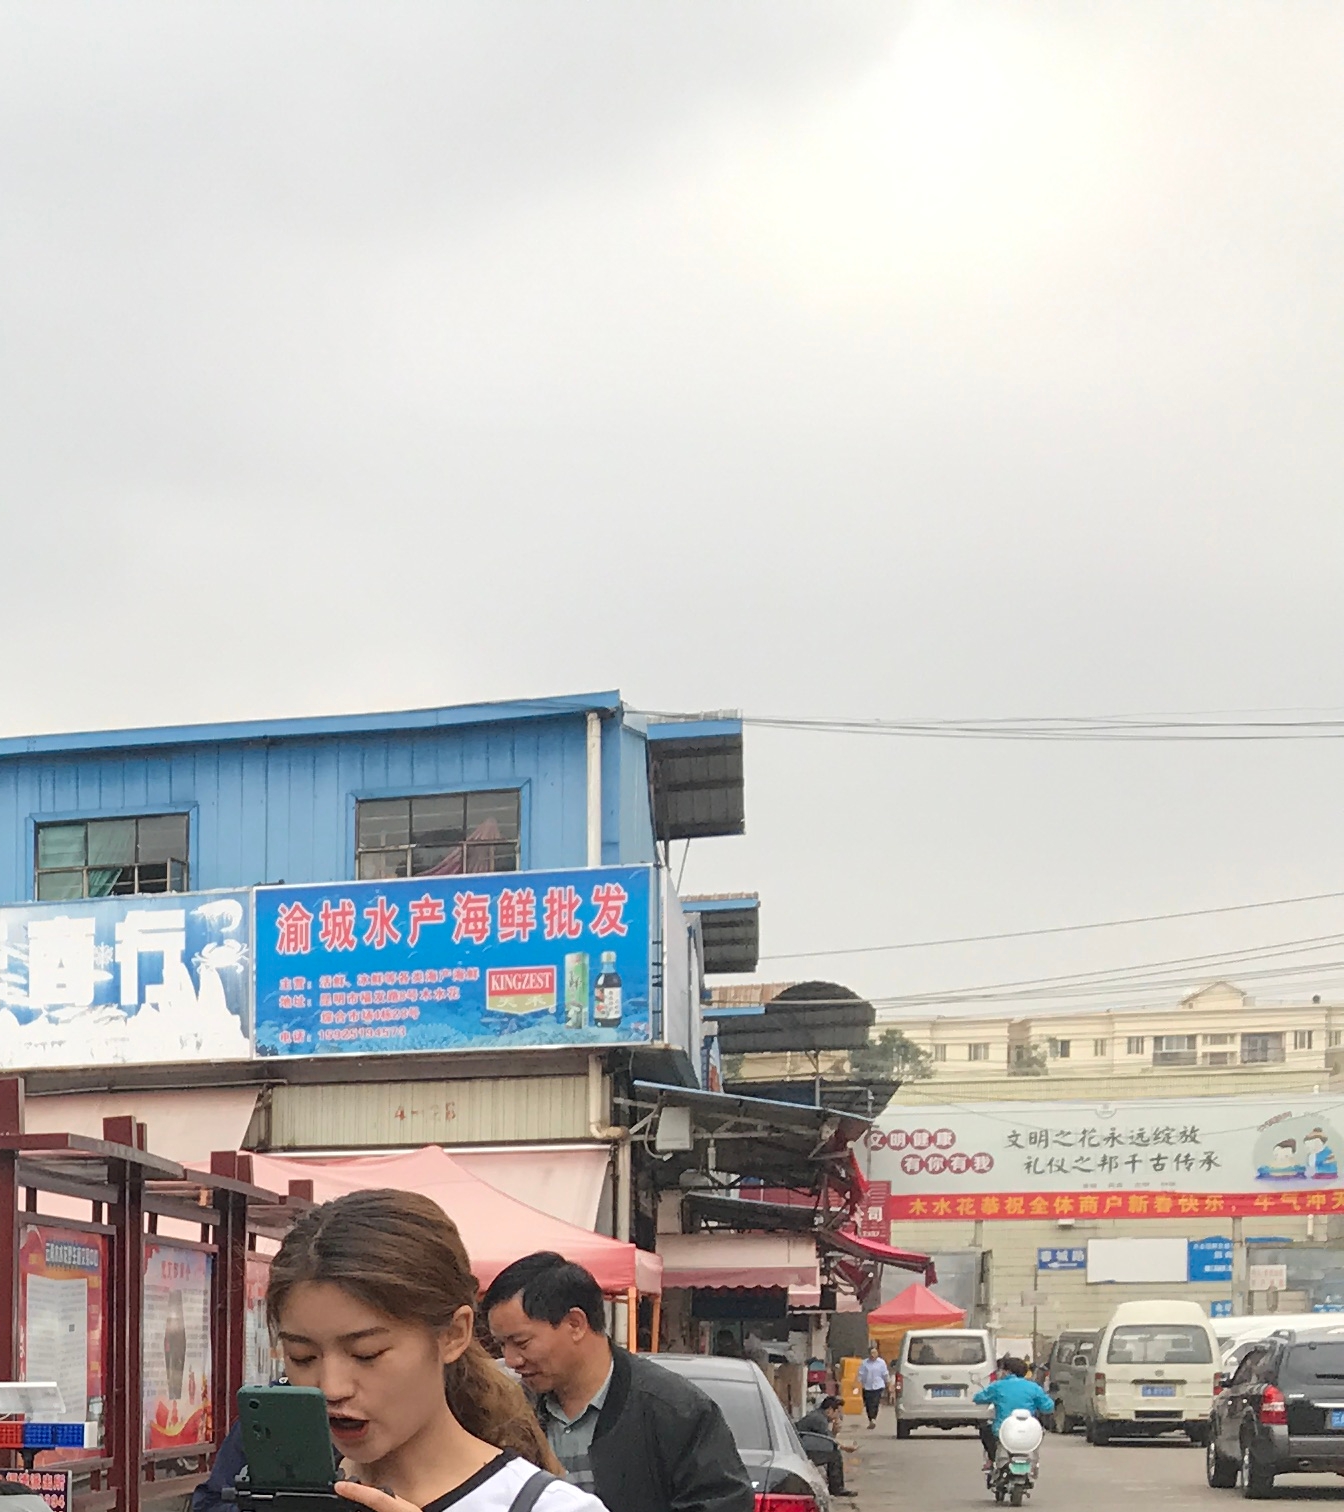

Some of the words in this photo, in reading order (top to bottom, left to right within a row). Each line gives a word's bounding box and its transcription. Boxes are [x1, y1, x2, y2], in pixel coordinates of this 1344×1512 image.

[276, 882, 630, 956] 渝城水产海鲜批发
[490, 972, 553, 991] KINGZEST
[865, 1127, 956, 1151] 文明健康
[1007, 1125, 1201, 1150] 文明之花永远绽放
[901, 1152, 995, 1176] 有你有我
[1024, 1151, 1222, 1176] 礼仪之邦千古传承
